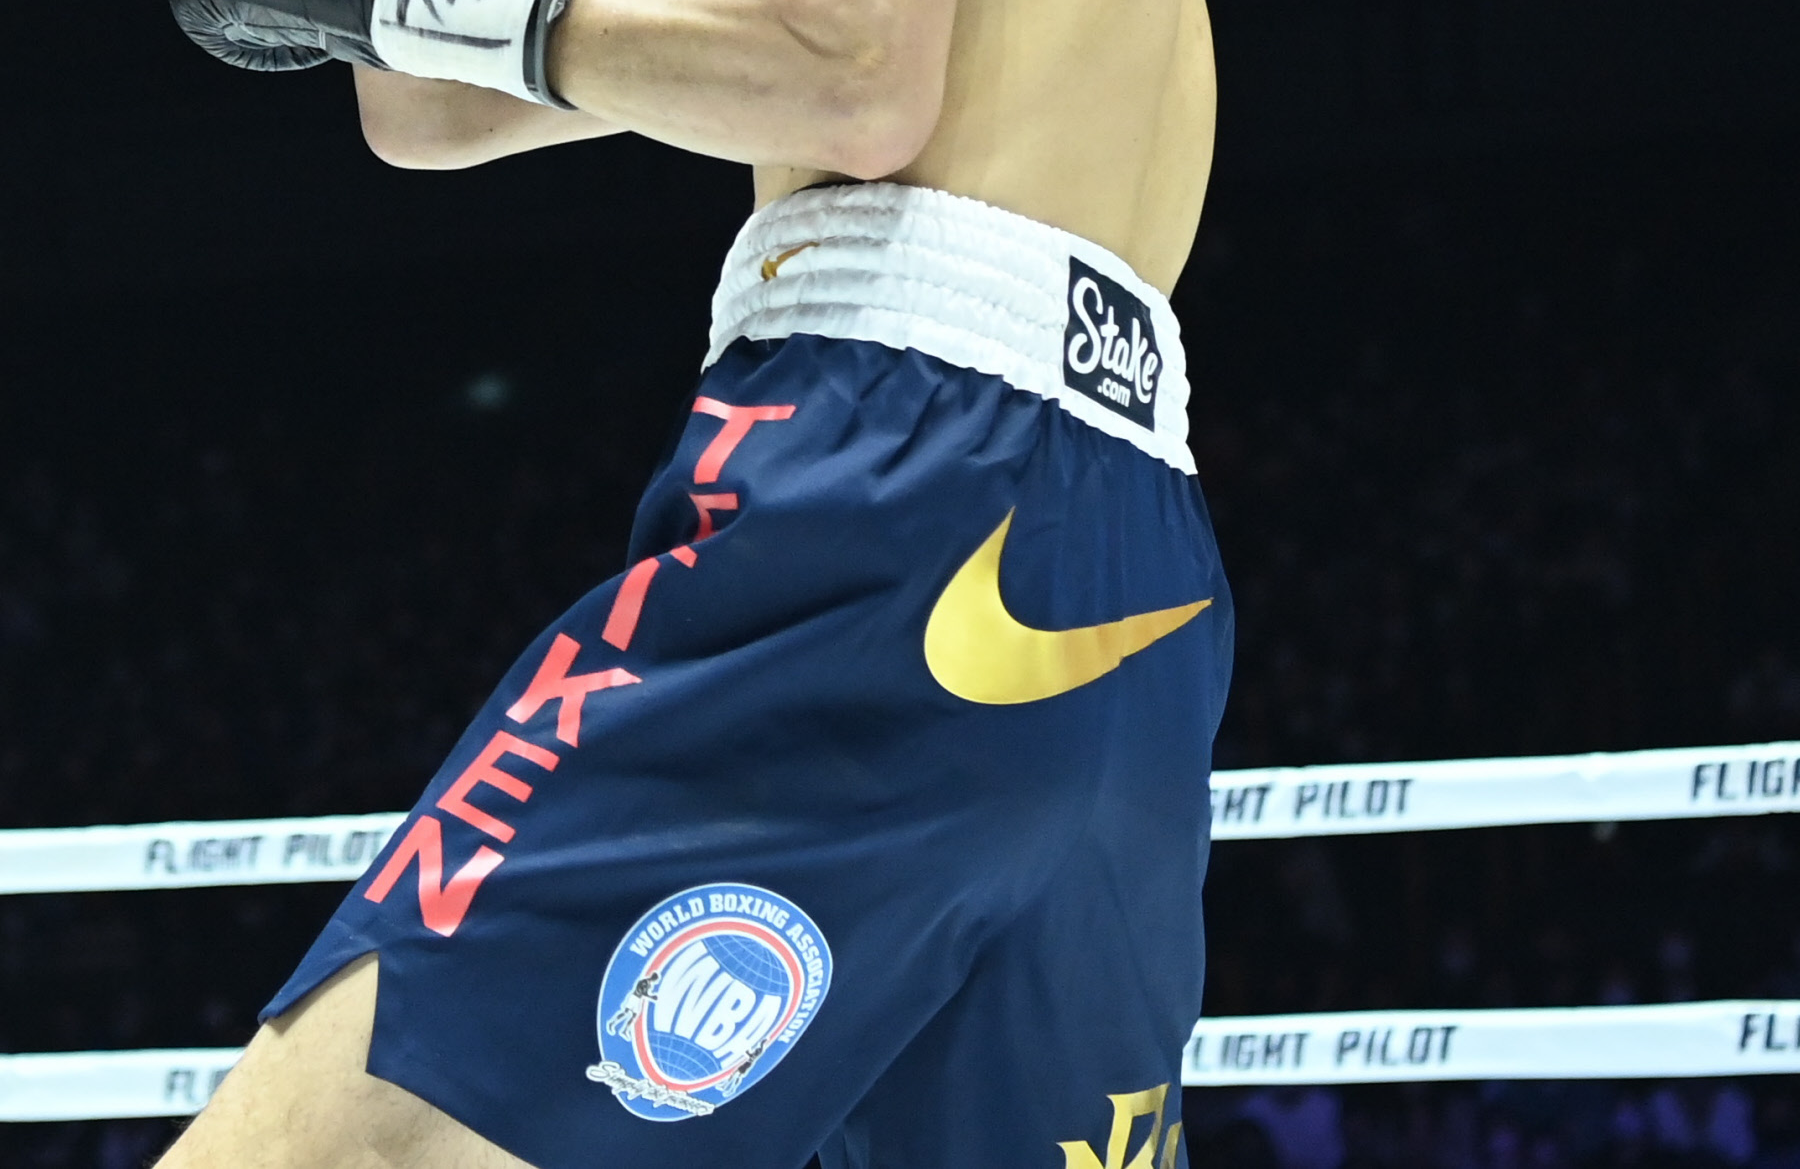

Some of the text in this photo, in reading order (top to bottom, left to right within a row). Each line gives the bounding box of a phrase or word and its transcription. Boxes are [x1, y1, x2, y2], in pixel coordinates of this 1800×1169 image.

[1068, 276, 1159, 404] Stake
[1097, 377, 1131, 408] .com
[1295, 779, 1414, 819] PILOT
[1692, 758, 1800, 799] FLIG
[630, 893, 824, 1044] WORLD BOXING ASSOCIATION
[653, 940, 782, 1072] WBA
[1192, 1025, 1459, 1072] LIGHT PILOT
